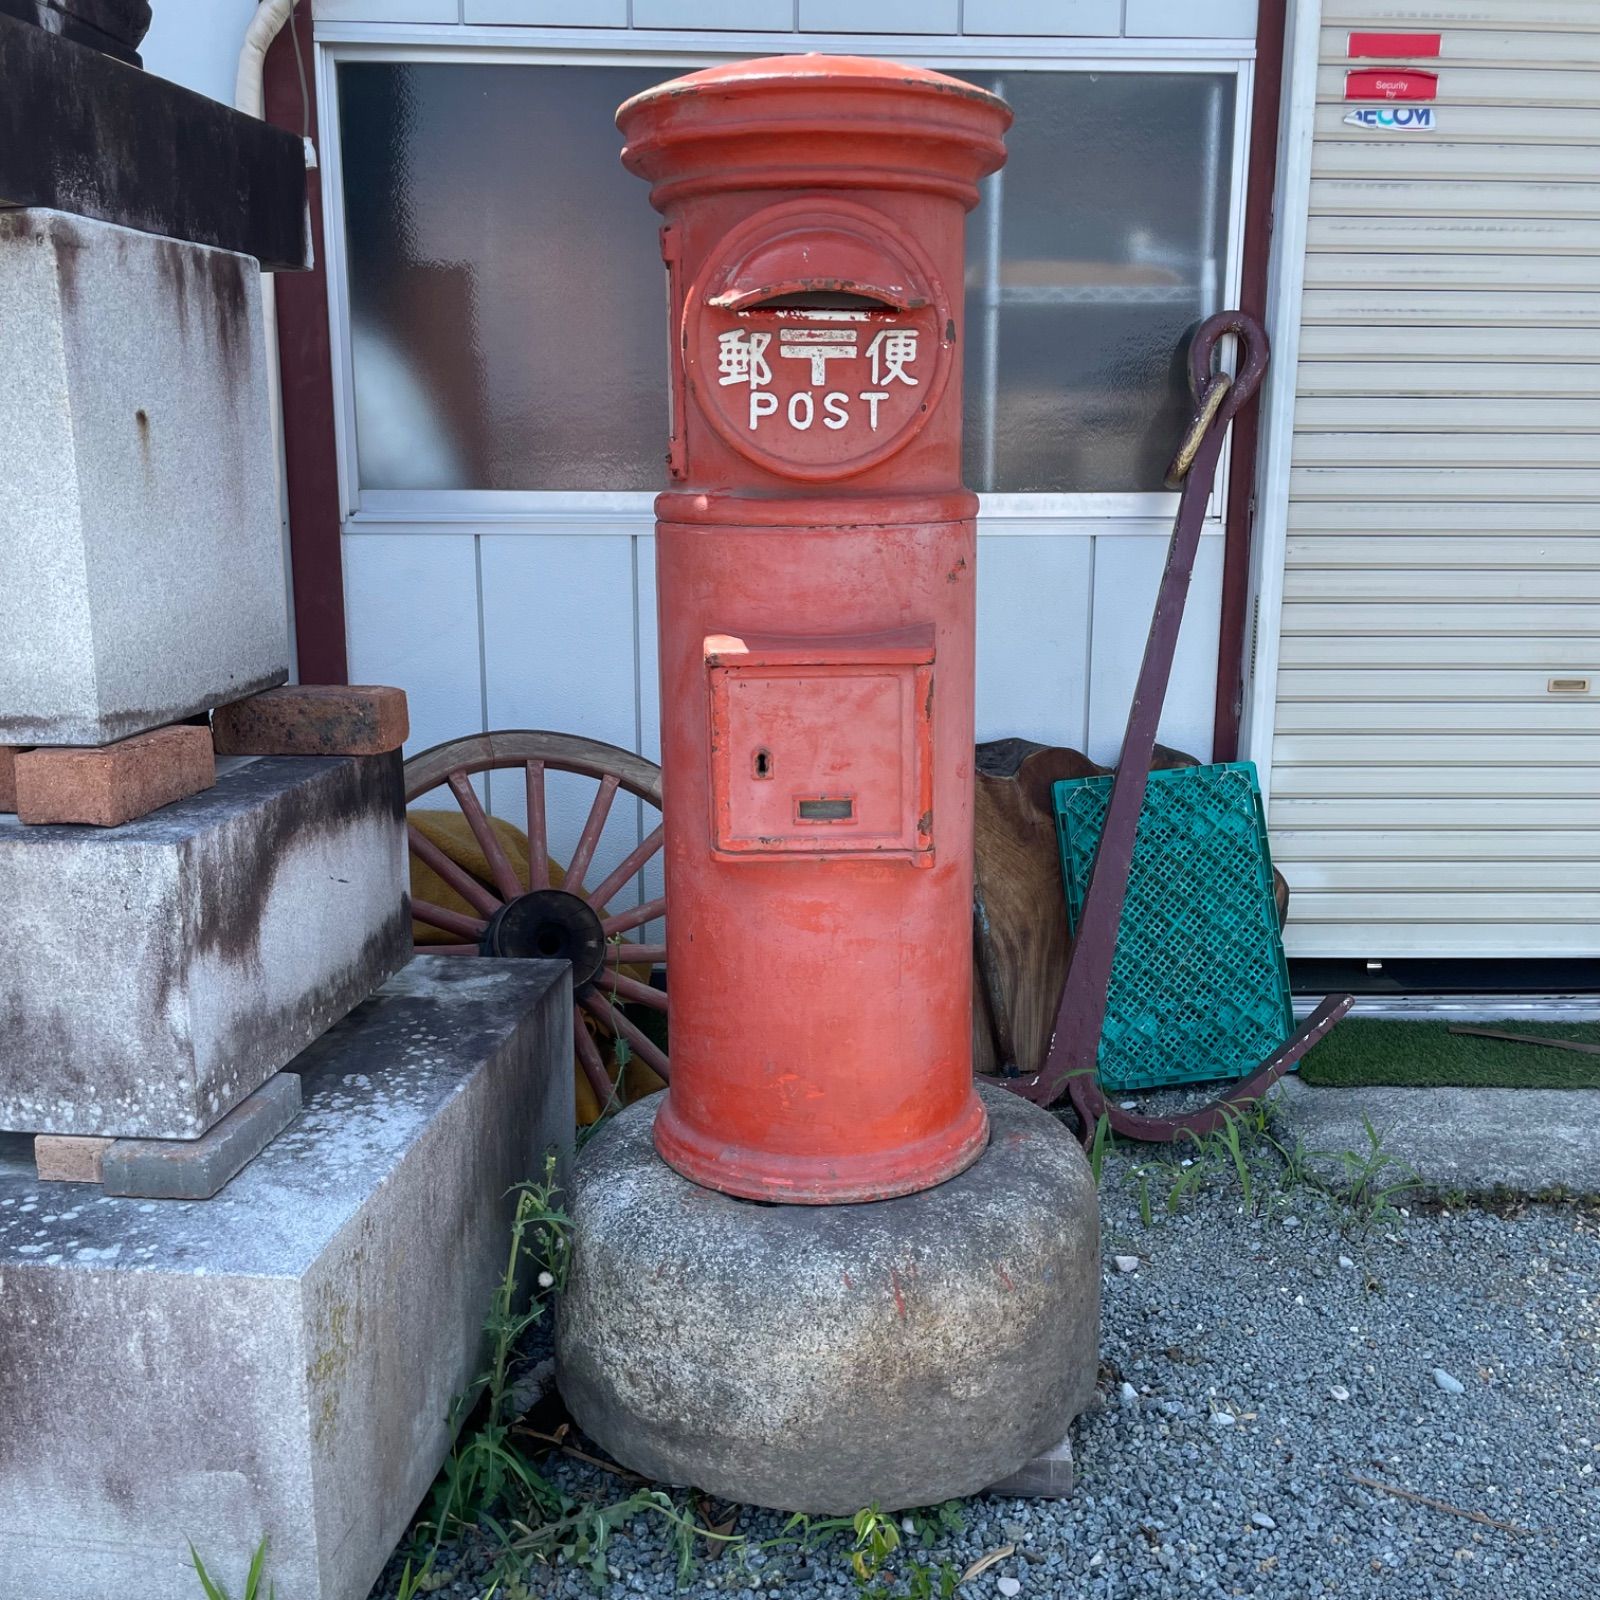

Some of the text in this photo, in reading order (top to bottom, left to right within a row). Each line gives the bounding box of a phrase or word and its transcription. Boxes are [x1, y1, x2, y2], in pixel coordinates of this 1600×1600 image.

[1375, 80, 1408, 91] Security
[1385, 90, 1396, 98] by
[748, 391, 890, 432] POST
